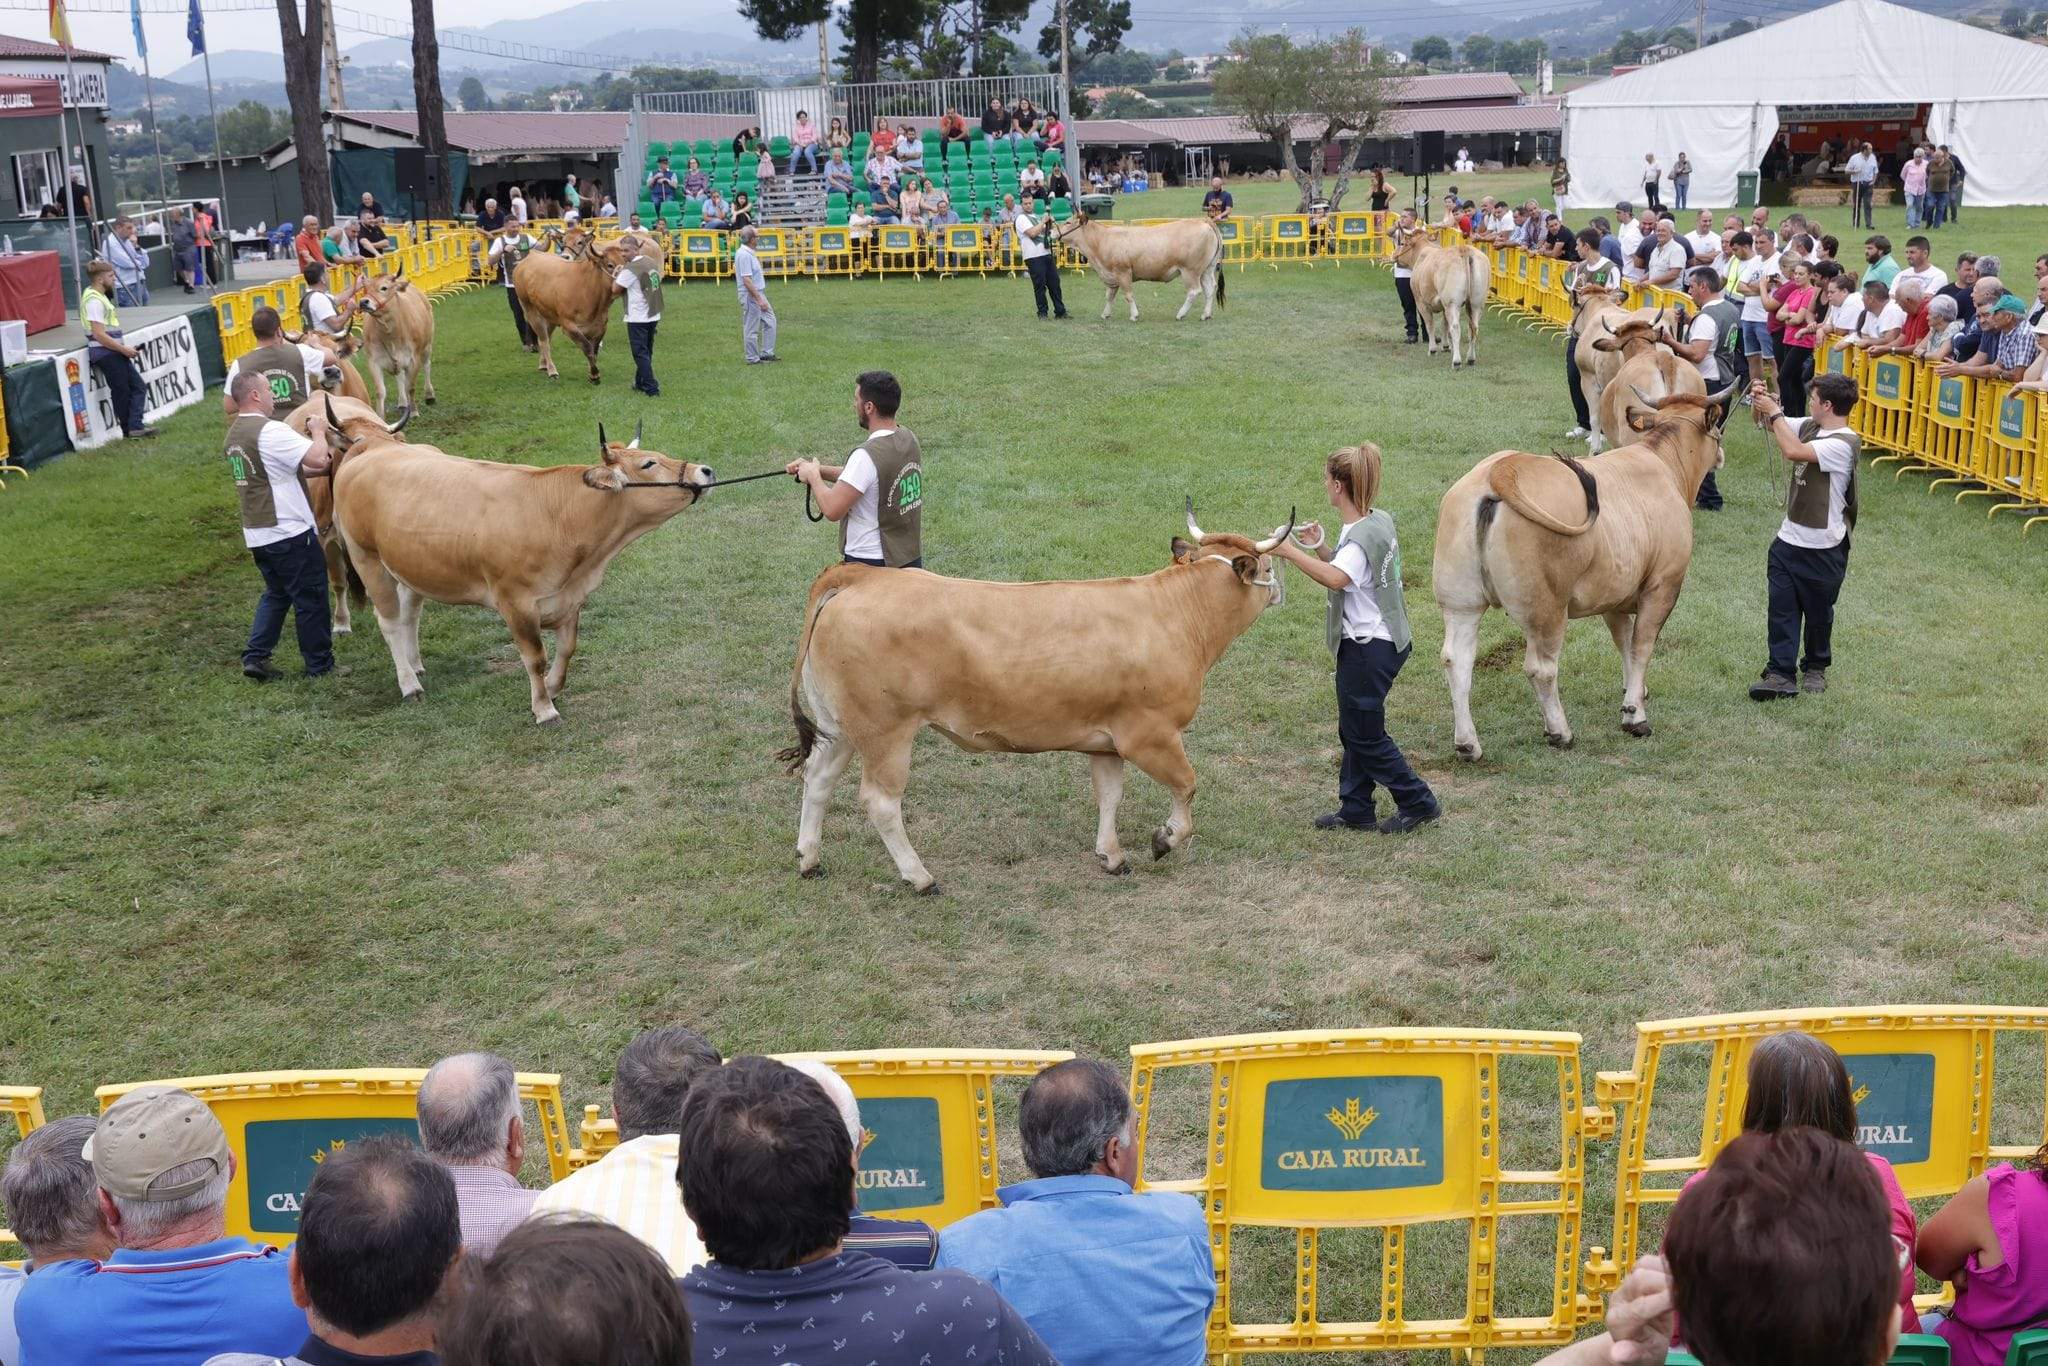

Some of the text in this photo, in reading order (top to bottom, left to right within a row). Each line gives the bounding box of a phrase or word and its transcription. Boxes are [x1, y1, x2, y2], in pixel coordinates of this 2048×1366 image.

[1278, 1147, 1426, 1171] CAJA RURAL
[266, 1192, 306, 1212] CA
